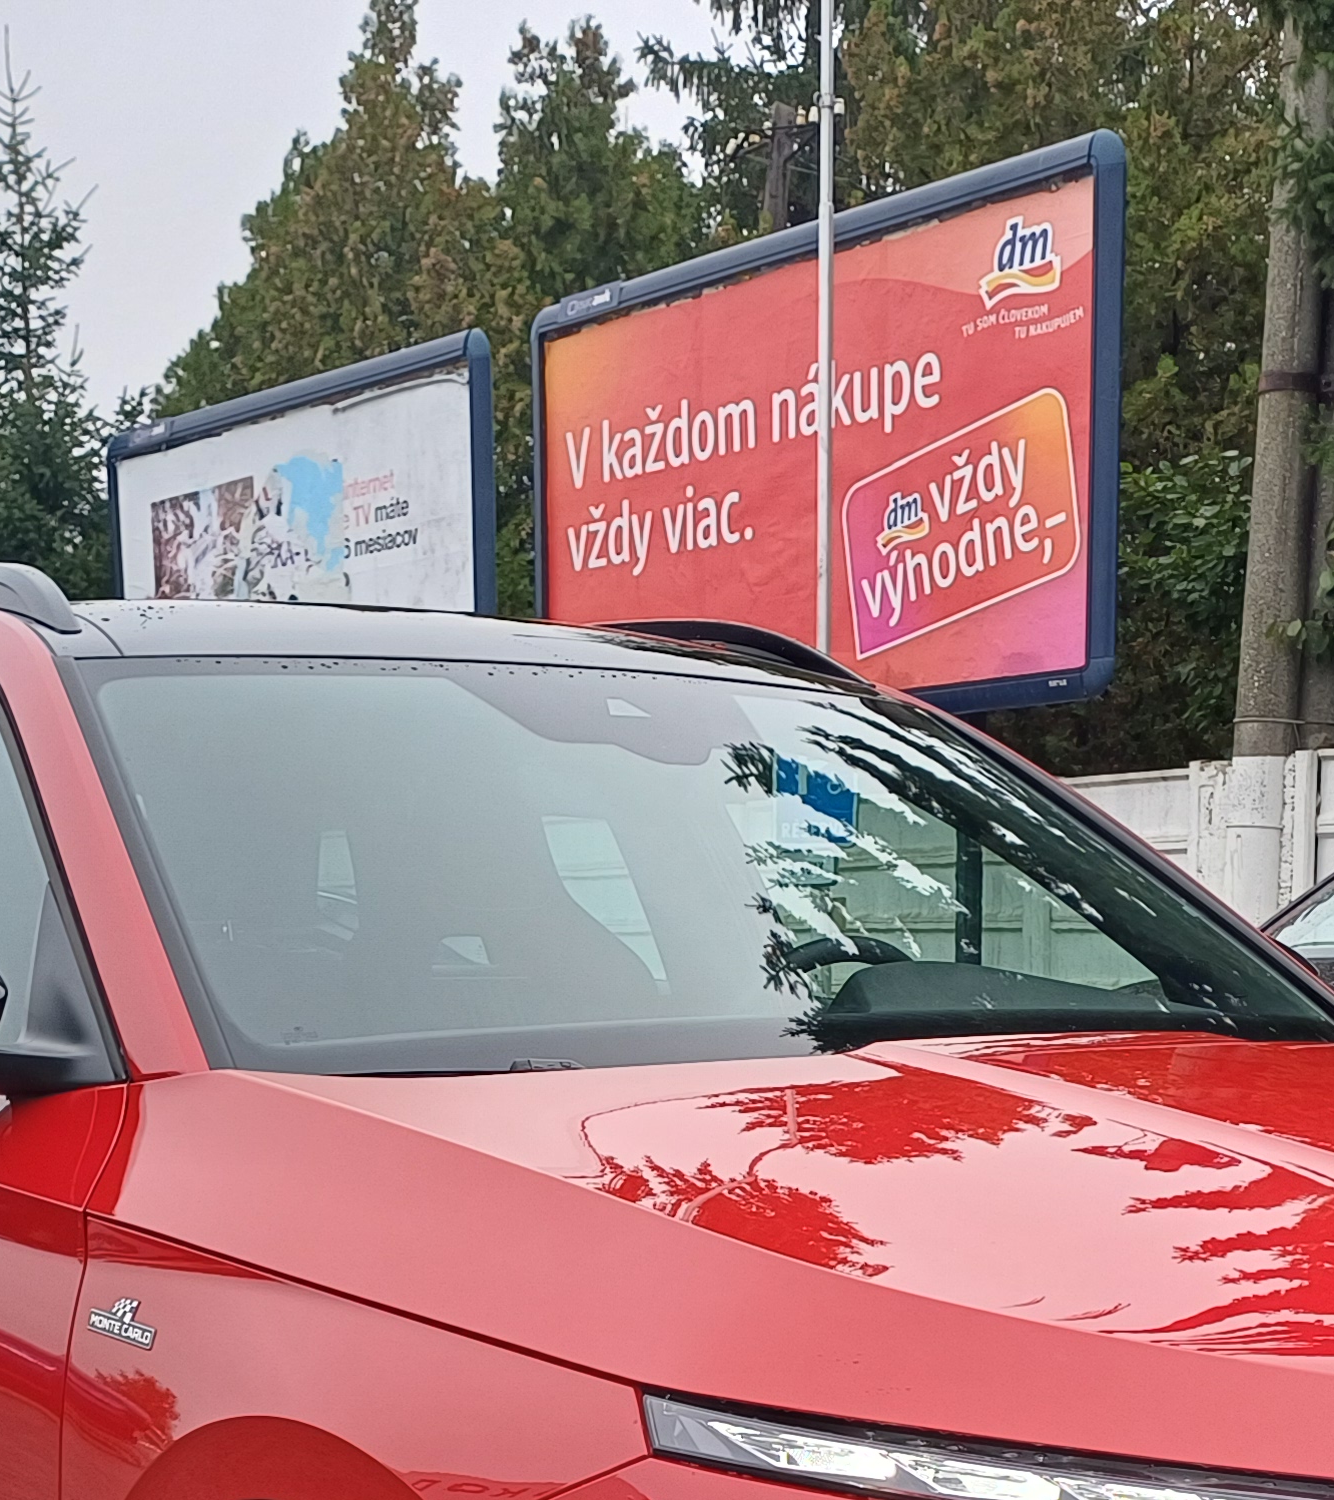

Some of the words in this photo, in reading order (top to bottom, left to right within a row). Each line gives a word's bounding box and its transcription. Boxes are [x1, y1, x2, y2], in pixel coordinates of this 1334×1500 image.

[998, 222, 1049, 272] dm
[961, 323, 975, 338] TU
[976, 312, 997, 332] SOM
[1014, 326, 1028, 339] TU
[565, 426, 591, 490] V
[601, 398, 756, 483] každom
[771, 351, 942, 443] nákupe
[886, 496, 920, 531] dm
[928, 437, 1026, 523] vždy
[353, 503, 372, 527] TV
[374, 496, 410, 523] máte
[354, 527, 419, 557] mesiacov
[567, 498, 653, 577] vždy
[662, 484, 754, 554] viac.
[89, 1313, 122, 1334] MONTE
[121, 1324, 152, 1344] CARLO
